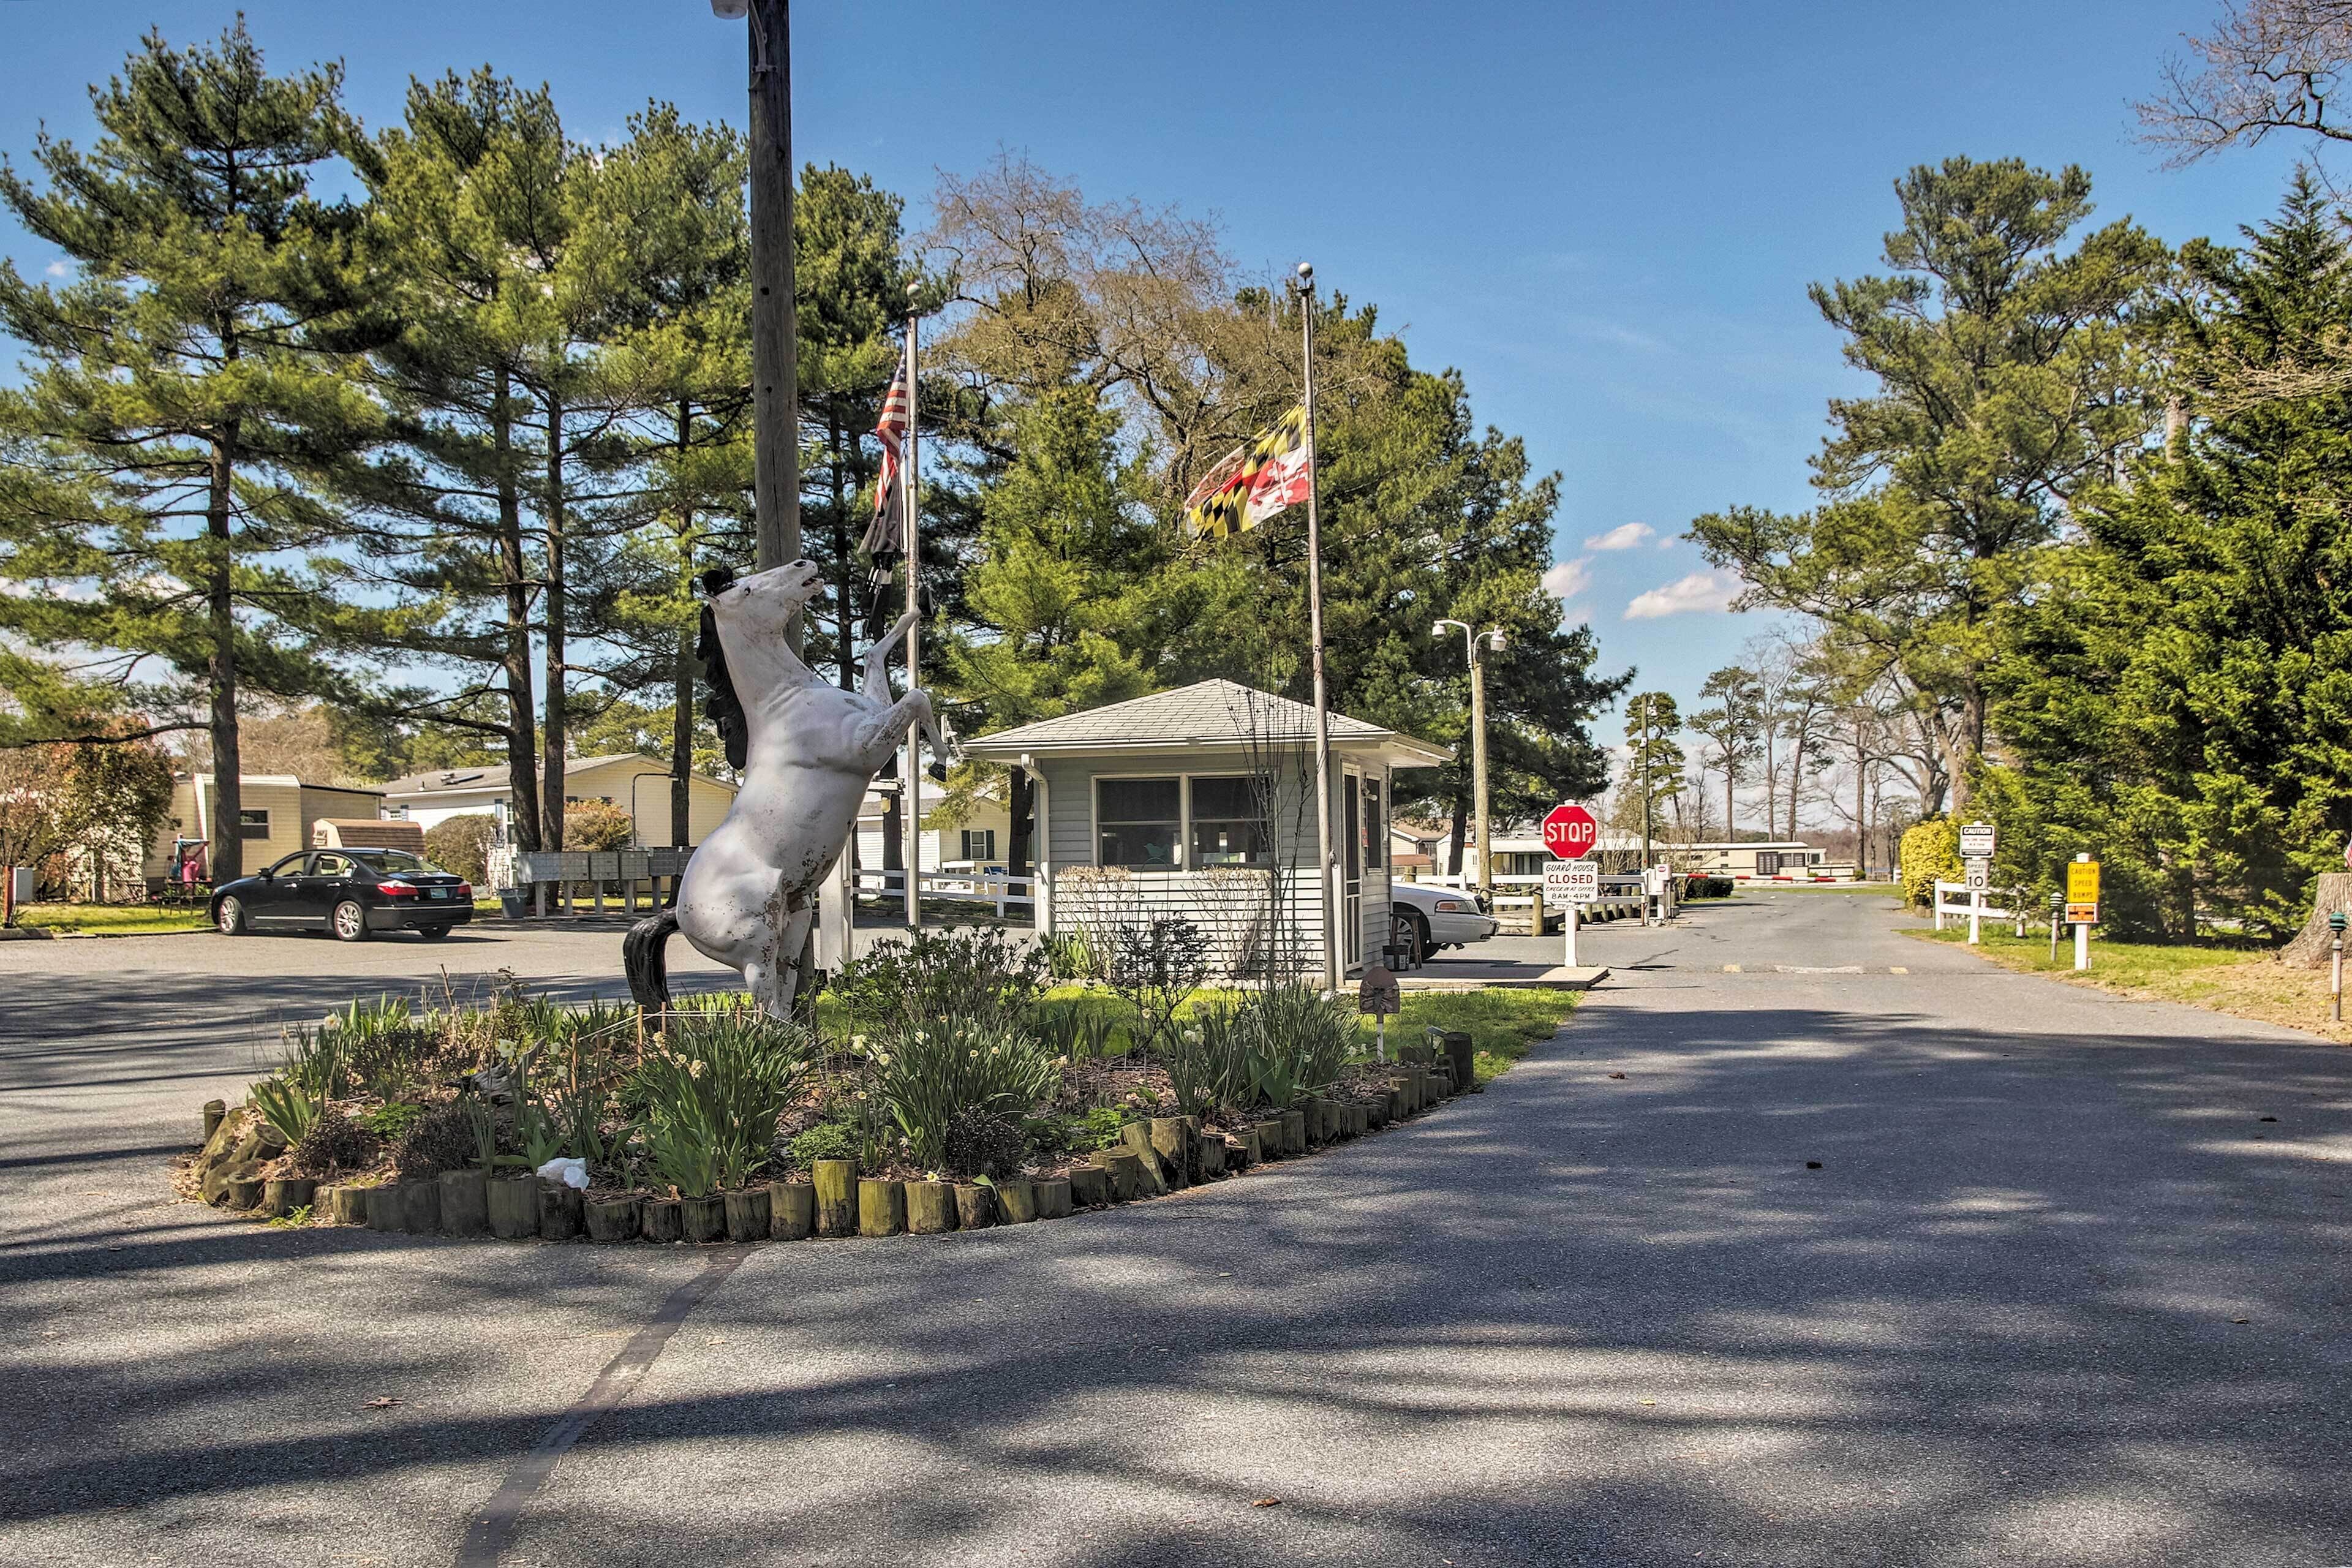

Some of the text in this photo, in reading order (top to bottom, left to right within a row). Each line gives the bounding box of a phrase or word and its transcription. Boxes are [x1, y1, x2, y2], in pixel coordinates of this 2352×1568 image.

[1547, 823, 1593, 843] STOP
[1548, 875, 1593, 883] CLOSED
[1969, 876, 1983, 886] 10
